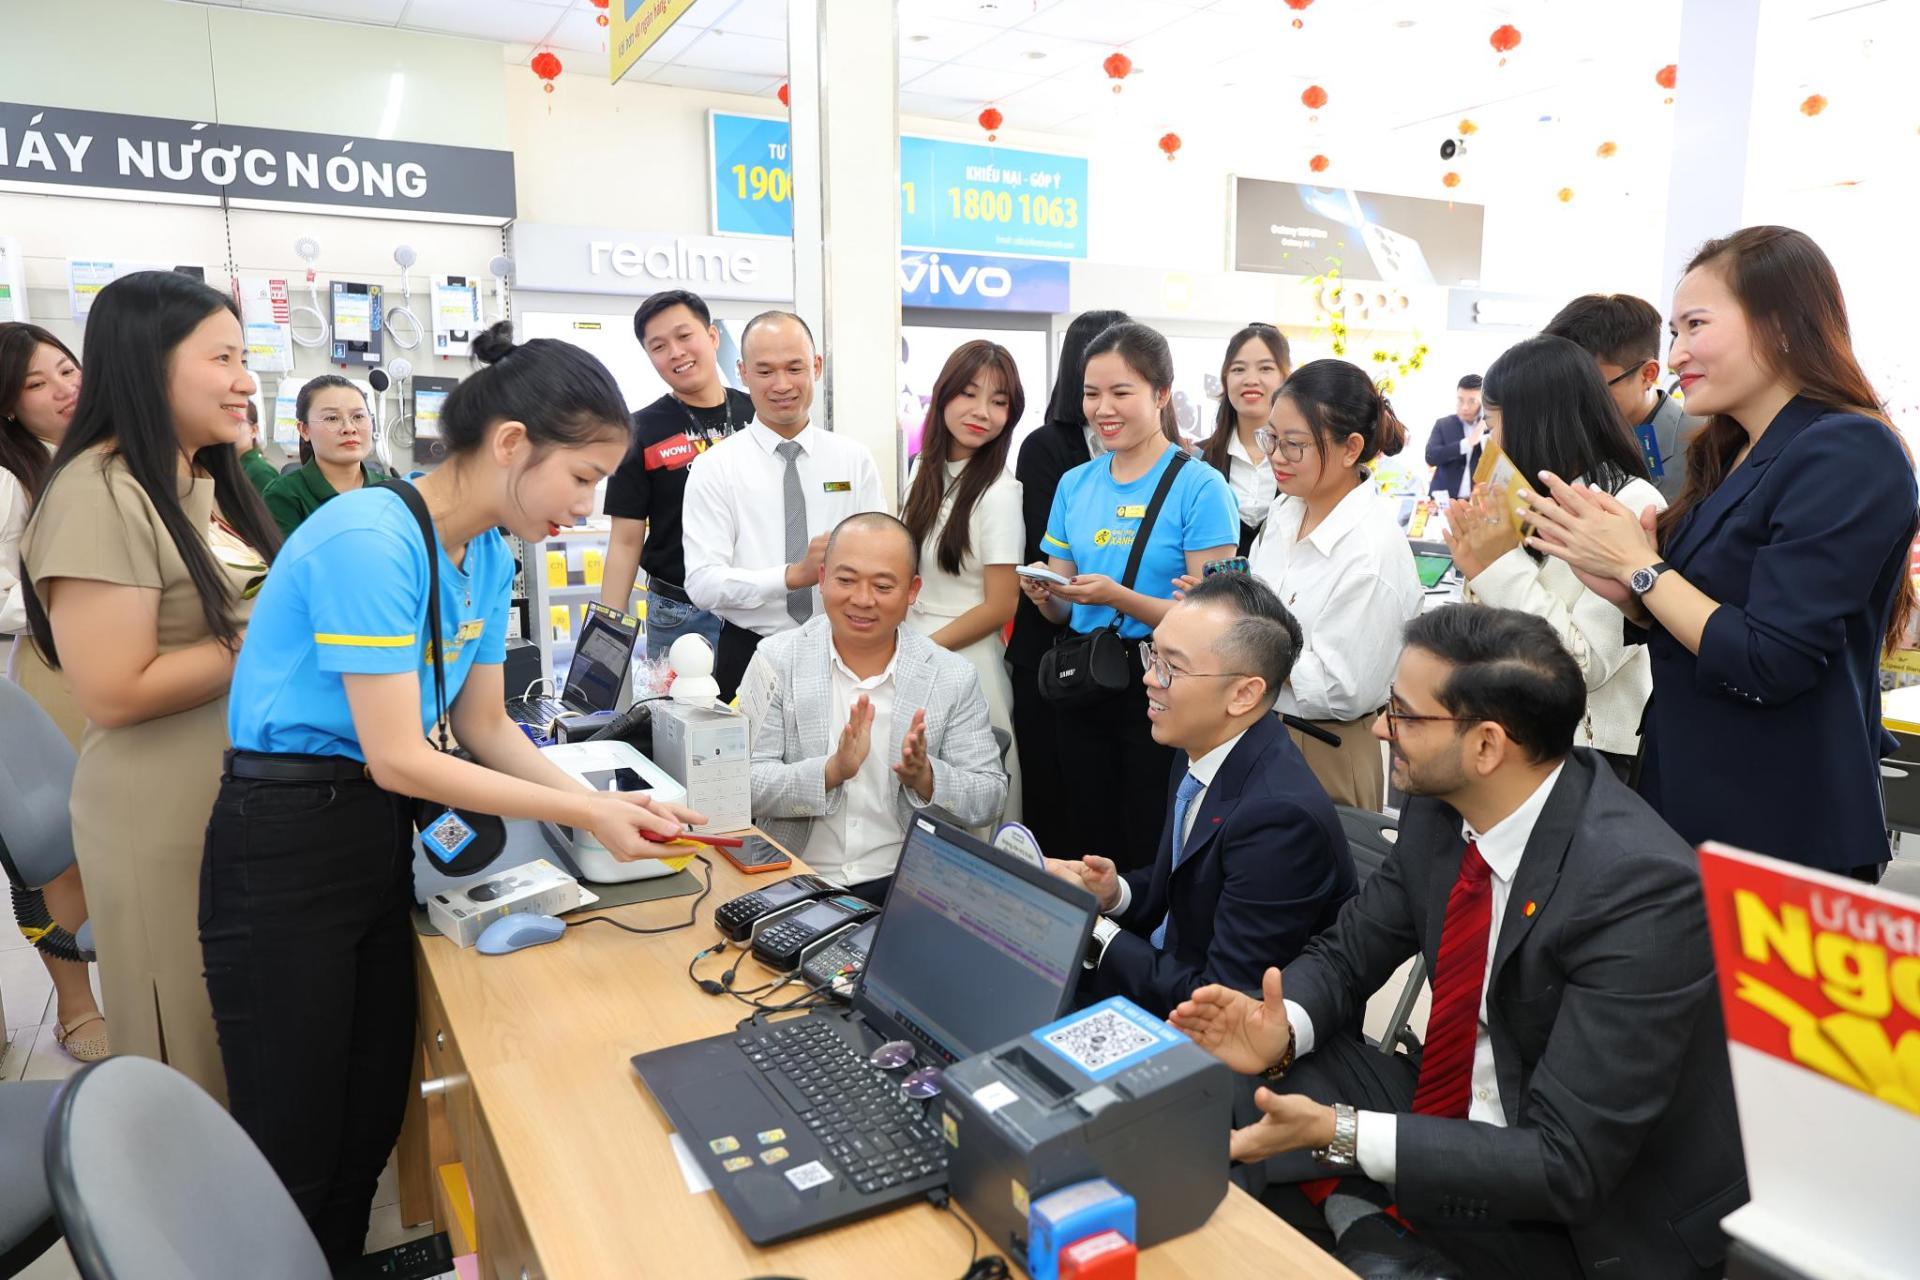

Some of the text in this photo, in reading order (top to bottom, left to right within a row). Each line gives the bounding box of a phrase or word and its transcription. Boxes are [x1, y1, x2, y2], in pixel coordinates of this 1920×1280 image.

[117, 122, 278, 187] NƯỚC
[286, 141, 428, 199] NÓNG
[965, 164, 1000, 183] KHIẾU
[1002, 171, 1022, 189] NẠI
[1029, 172, 1051, 188] GÓP
[948, 187, 1078, 229] 1800 1063
[589, 237, 759, 283] realme
[901, 253, 1012, 297] vivo
